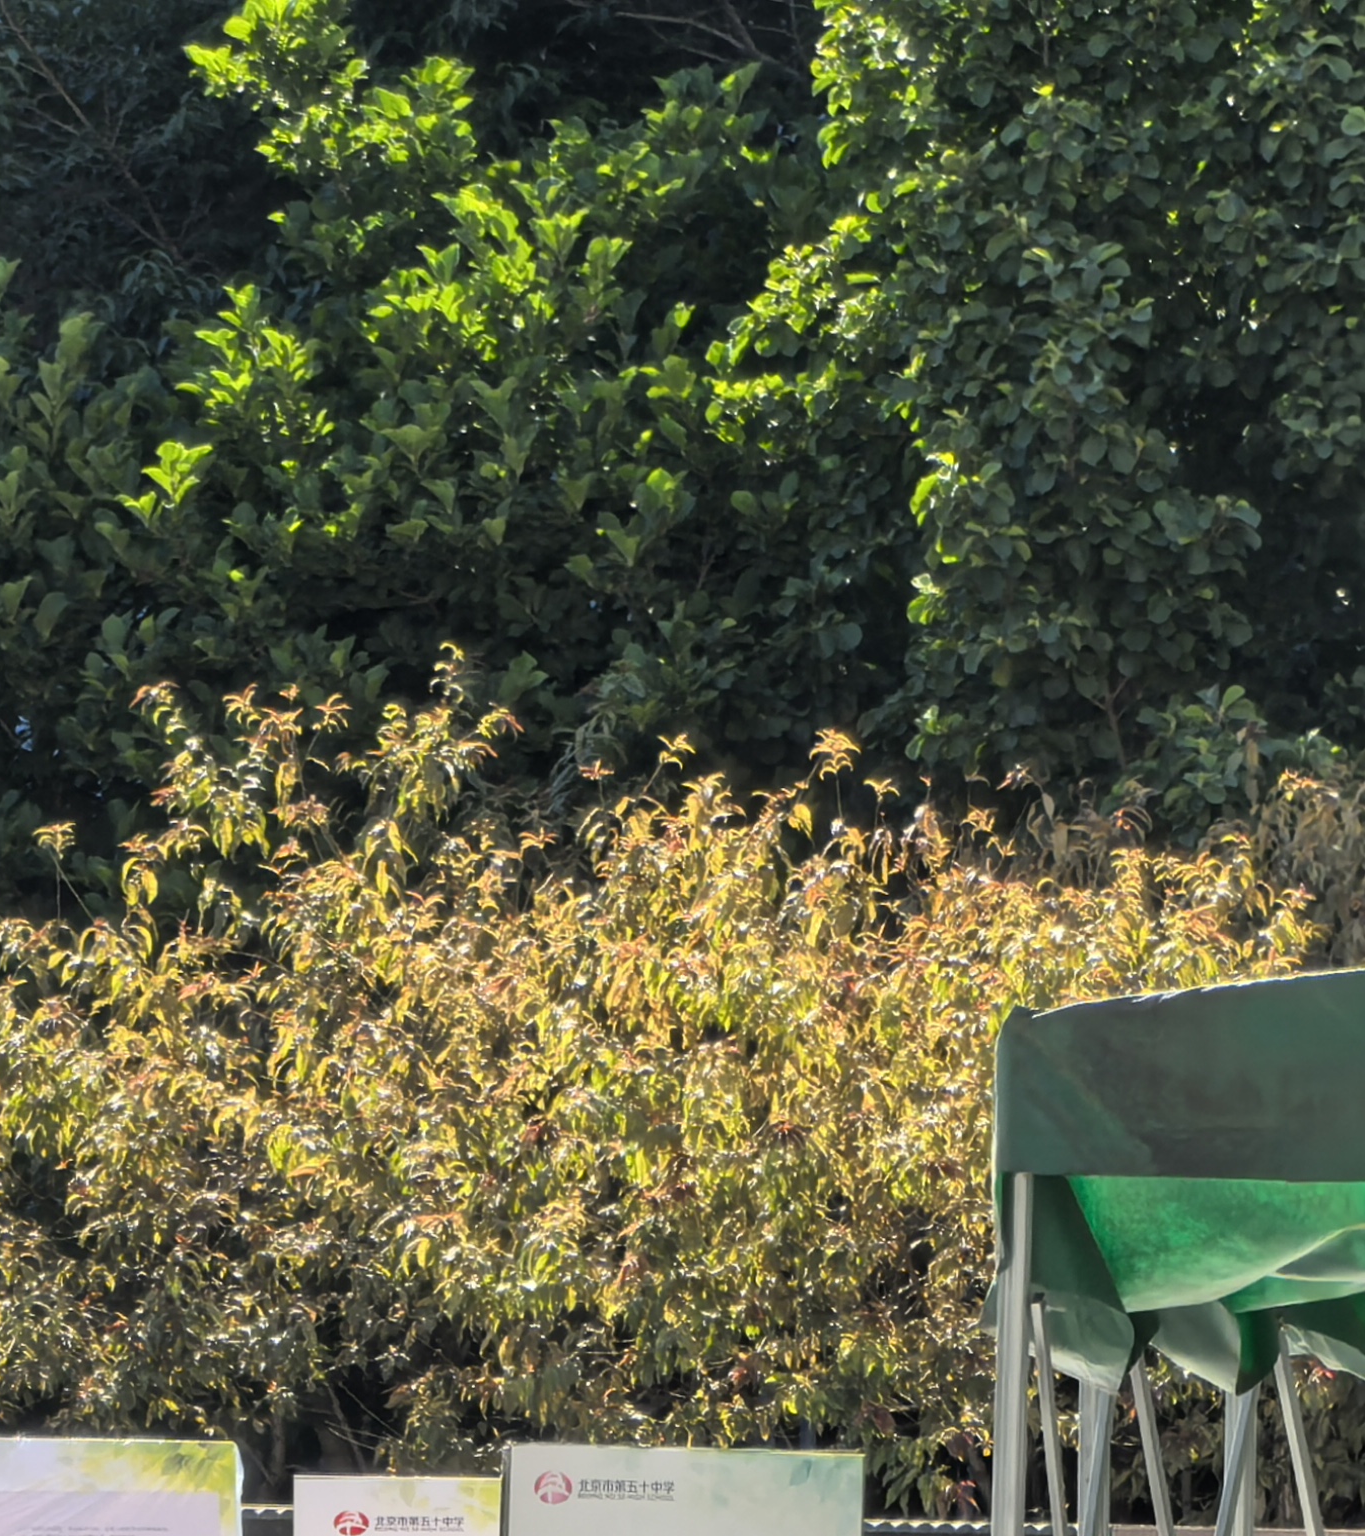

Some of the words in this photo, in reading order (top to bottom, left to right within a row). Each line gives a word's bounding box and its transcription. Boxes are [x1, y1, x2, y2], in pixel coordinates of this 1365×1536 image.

[577, 1479, 675, 1494] 北京市第五十中学
[375, 1516, 464, 1527] 北京市第五十中学
